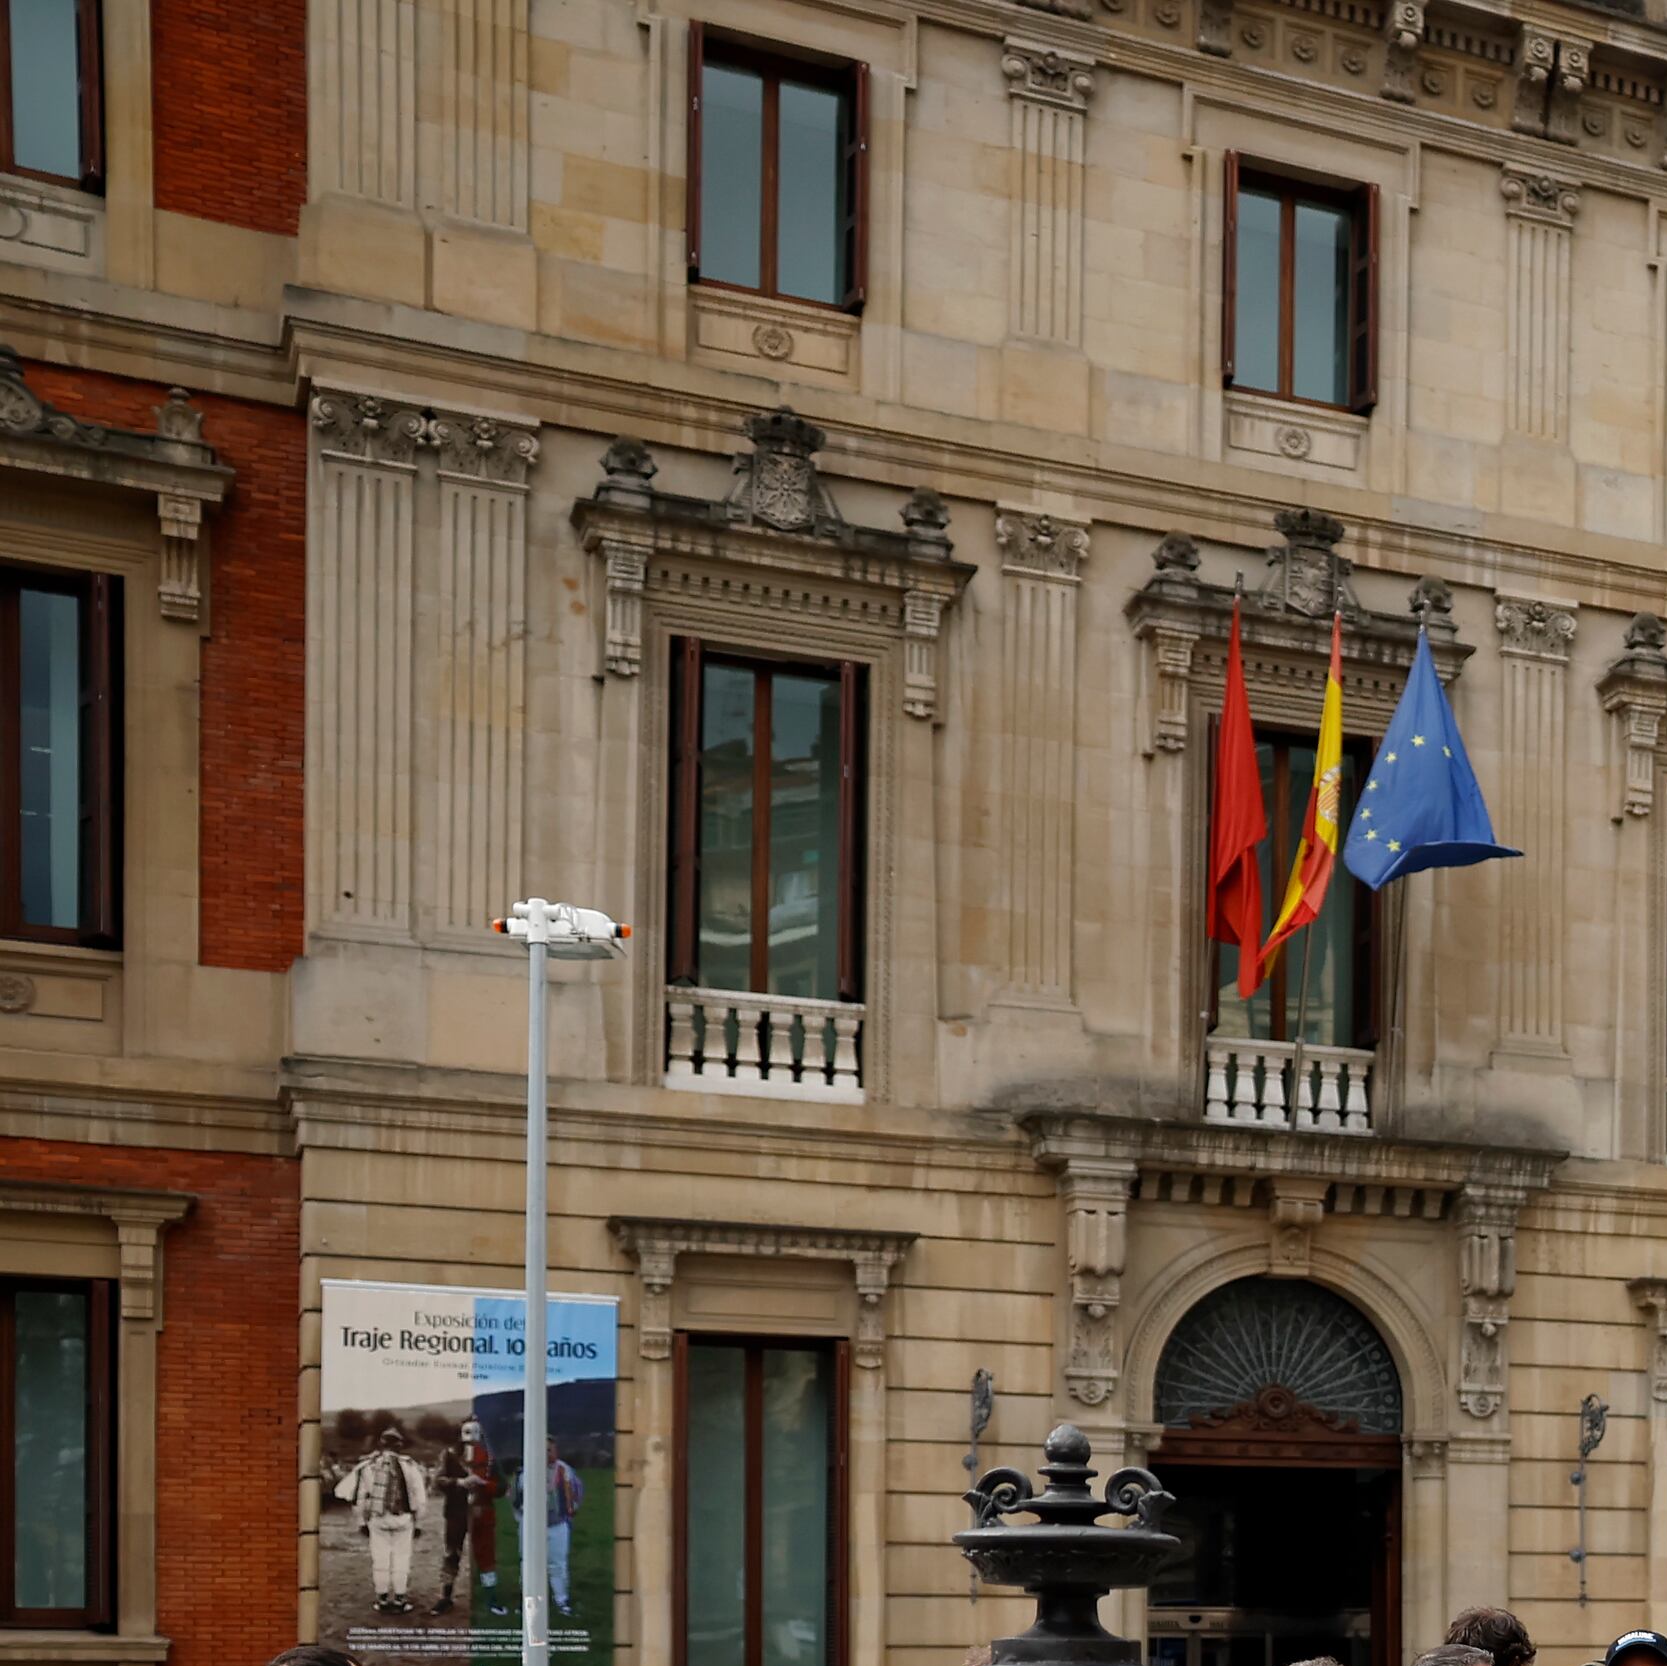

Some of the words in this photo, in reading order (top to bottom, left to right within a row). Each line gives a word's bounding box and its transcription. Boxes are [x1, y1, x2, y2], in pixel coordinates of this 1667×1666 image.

[413, 1310, 498, 1331] Exposición
[340, 1326, 392, 1352] Traje
[399, 1329, 499, 1356] Regional.
[506, 1338, 526, 1356] 10
[546, 1337, 598, 1360] años
